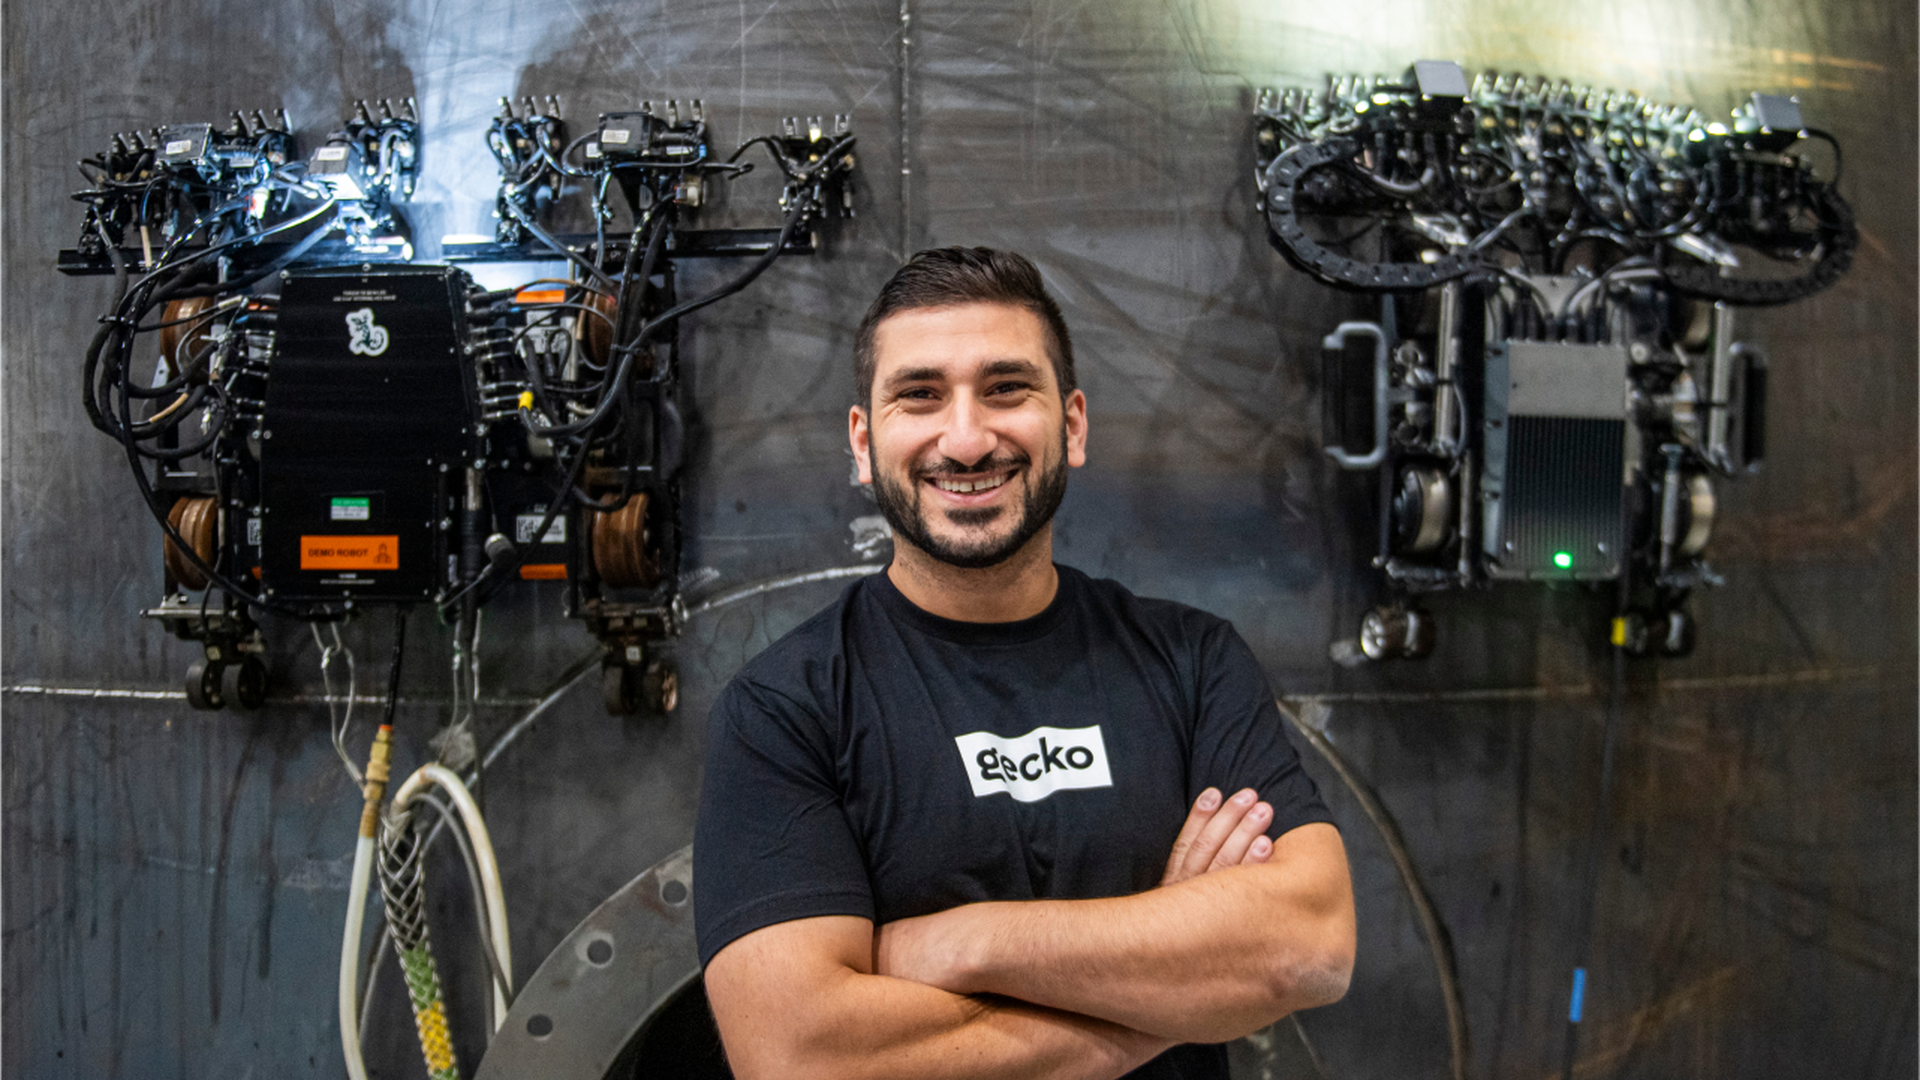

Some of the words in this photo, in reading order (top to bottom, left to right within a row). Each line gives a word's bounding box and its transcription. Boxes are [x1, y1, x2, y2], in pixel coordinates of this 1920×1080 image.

[308, 548, 335, 557] DEMO
[336, 548, 368, 557] ROBOT
[976, 736, 1094, 783] gecko
